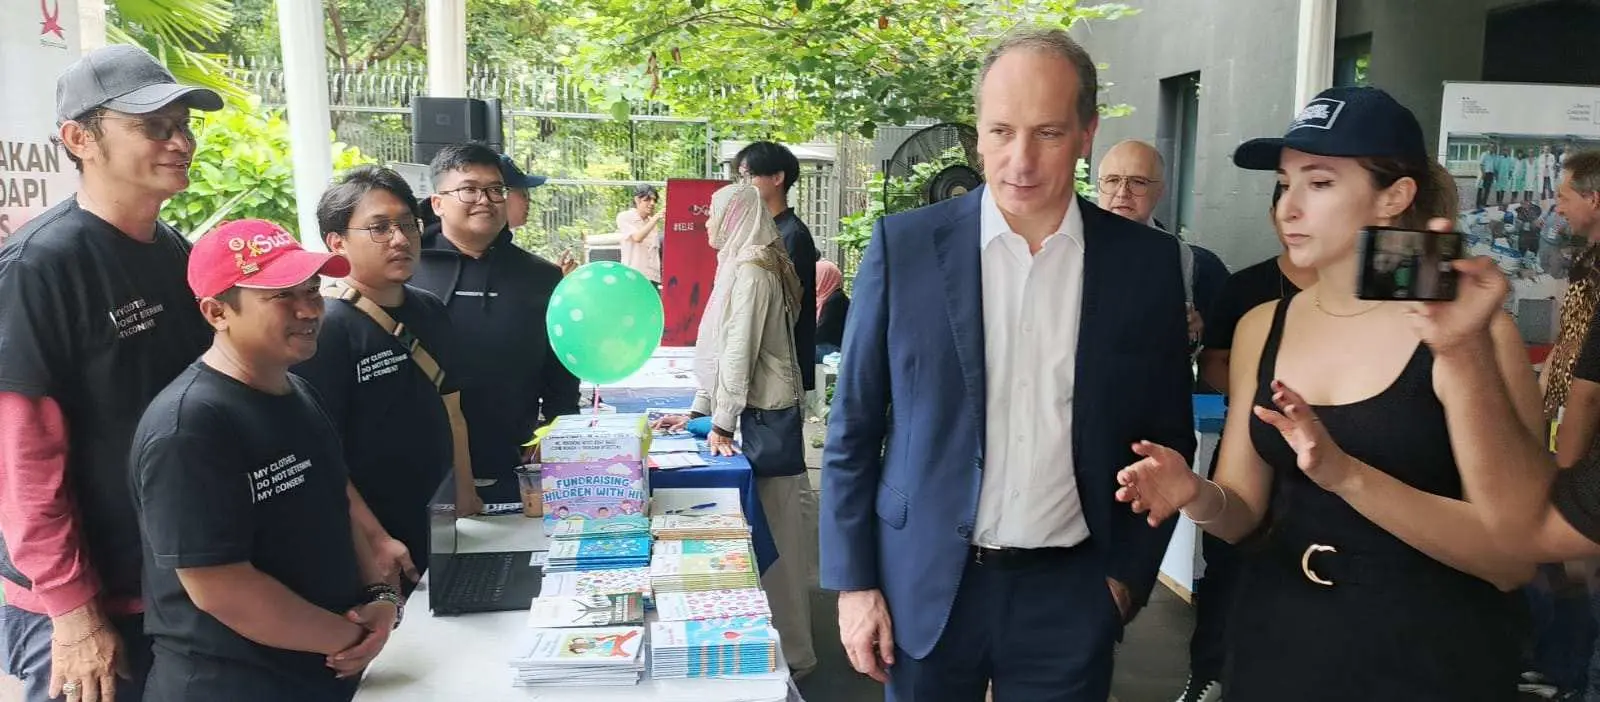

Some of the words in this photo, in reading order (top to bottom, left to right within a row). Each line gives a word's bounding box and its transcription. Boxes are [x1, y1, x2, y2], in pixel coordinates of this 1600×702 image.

[253, 467, 268, 480] MY
[257, 479, 270, 490] DO
[271, 471, 287, 484] NOT
[556, 475, 630, 489] FUNDRAISING
[257, 488, 273, 501] MY
[542, 487, 592, 501] HILDREN
[596, 487, 625, 498] WITH
